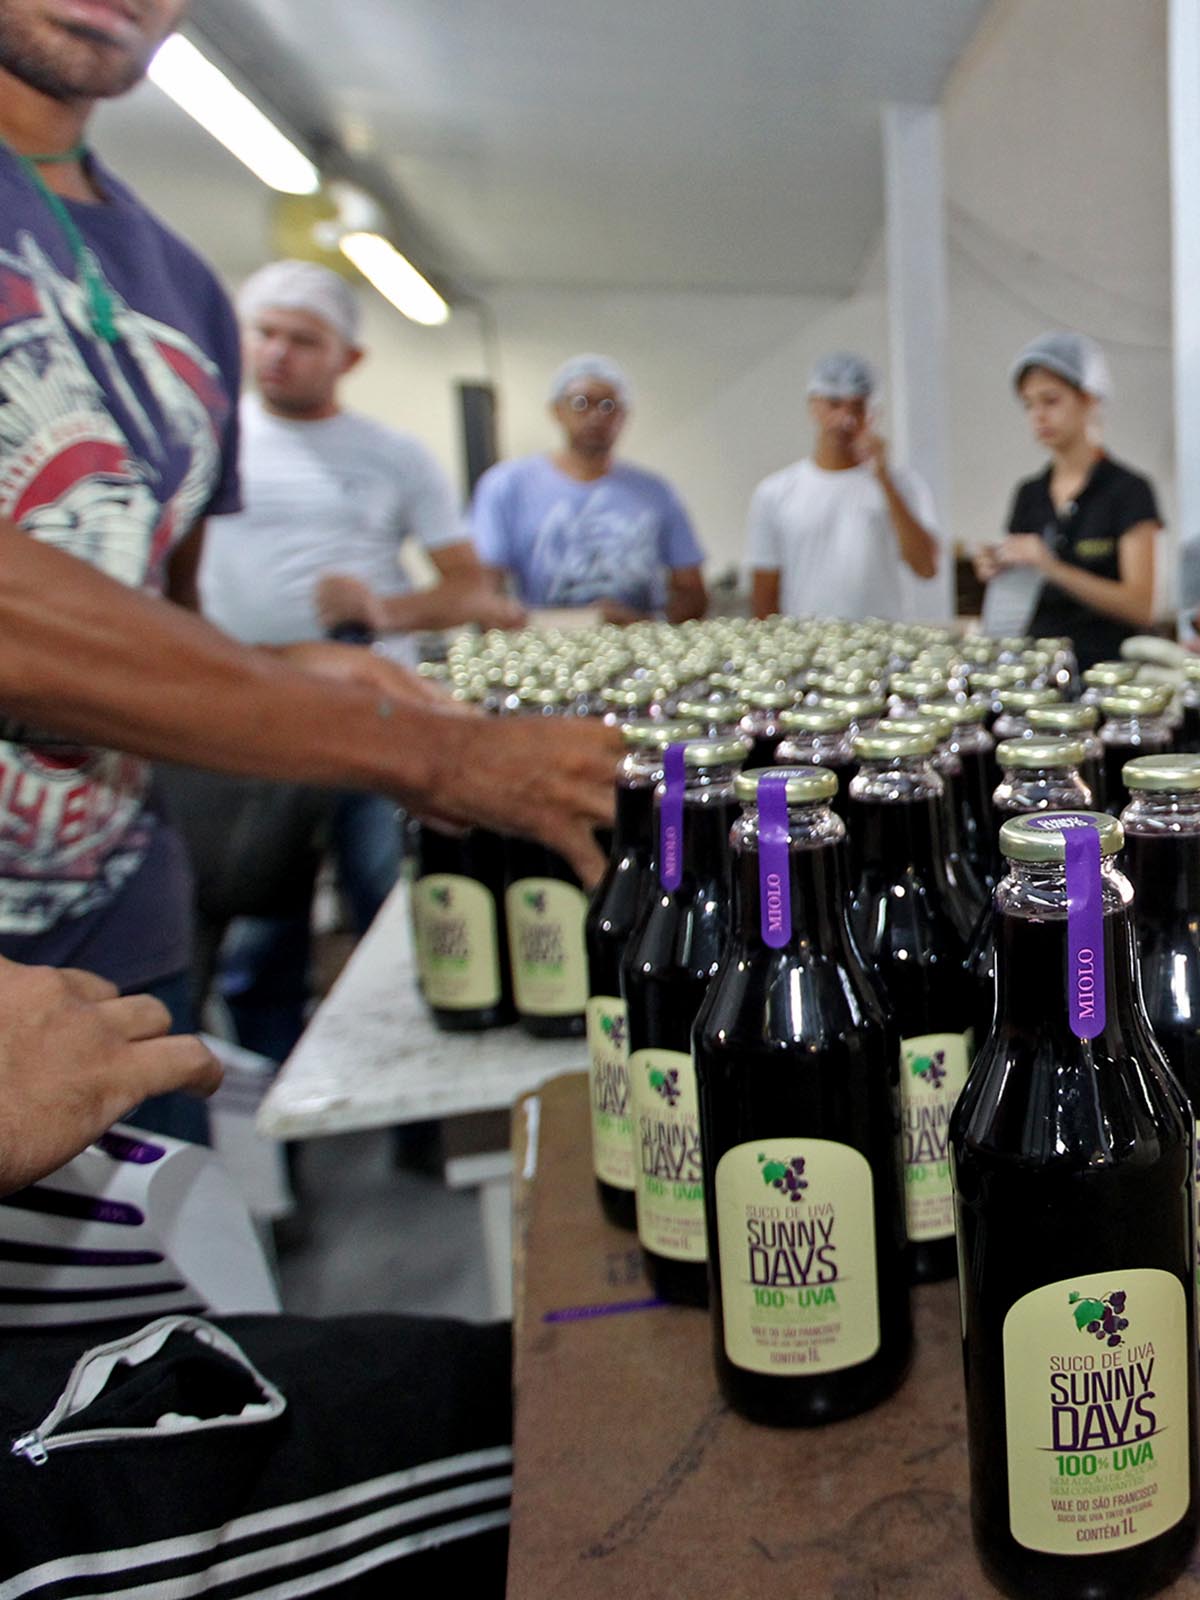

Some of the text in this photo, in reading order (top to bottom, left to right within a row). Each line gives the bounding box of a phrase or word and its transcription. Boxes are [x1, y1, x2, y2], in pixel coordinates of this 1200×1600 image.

[767, 873, 783, 933] MIOLO
[1077, 948, 1095, 1019] MIOLO
[808, 1202, 834, 1217] UVA
[747, 1216, 835, 1247] SUNNY
[750, 1244, 838, 1287] DAYS
[798, 1286, 836, 1309] UVA
[1050, 1341, 1155, 1372] SUCO DE UVA
[1050, 1357, 1154, 1406] SUNNY
[1052, 1391, 1156, 1451] DAYS
[1113, 1441, 1154, 1471] UVA
[1051, 1482, 1158, 1512] VALE DO SÃO FRANCISCO
[1076, 1517, 1137, 1542] CONTÉM 1L
